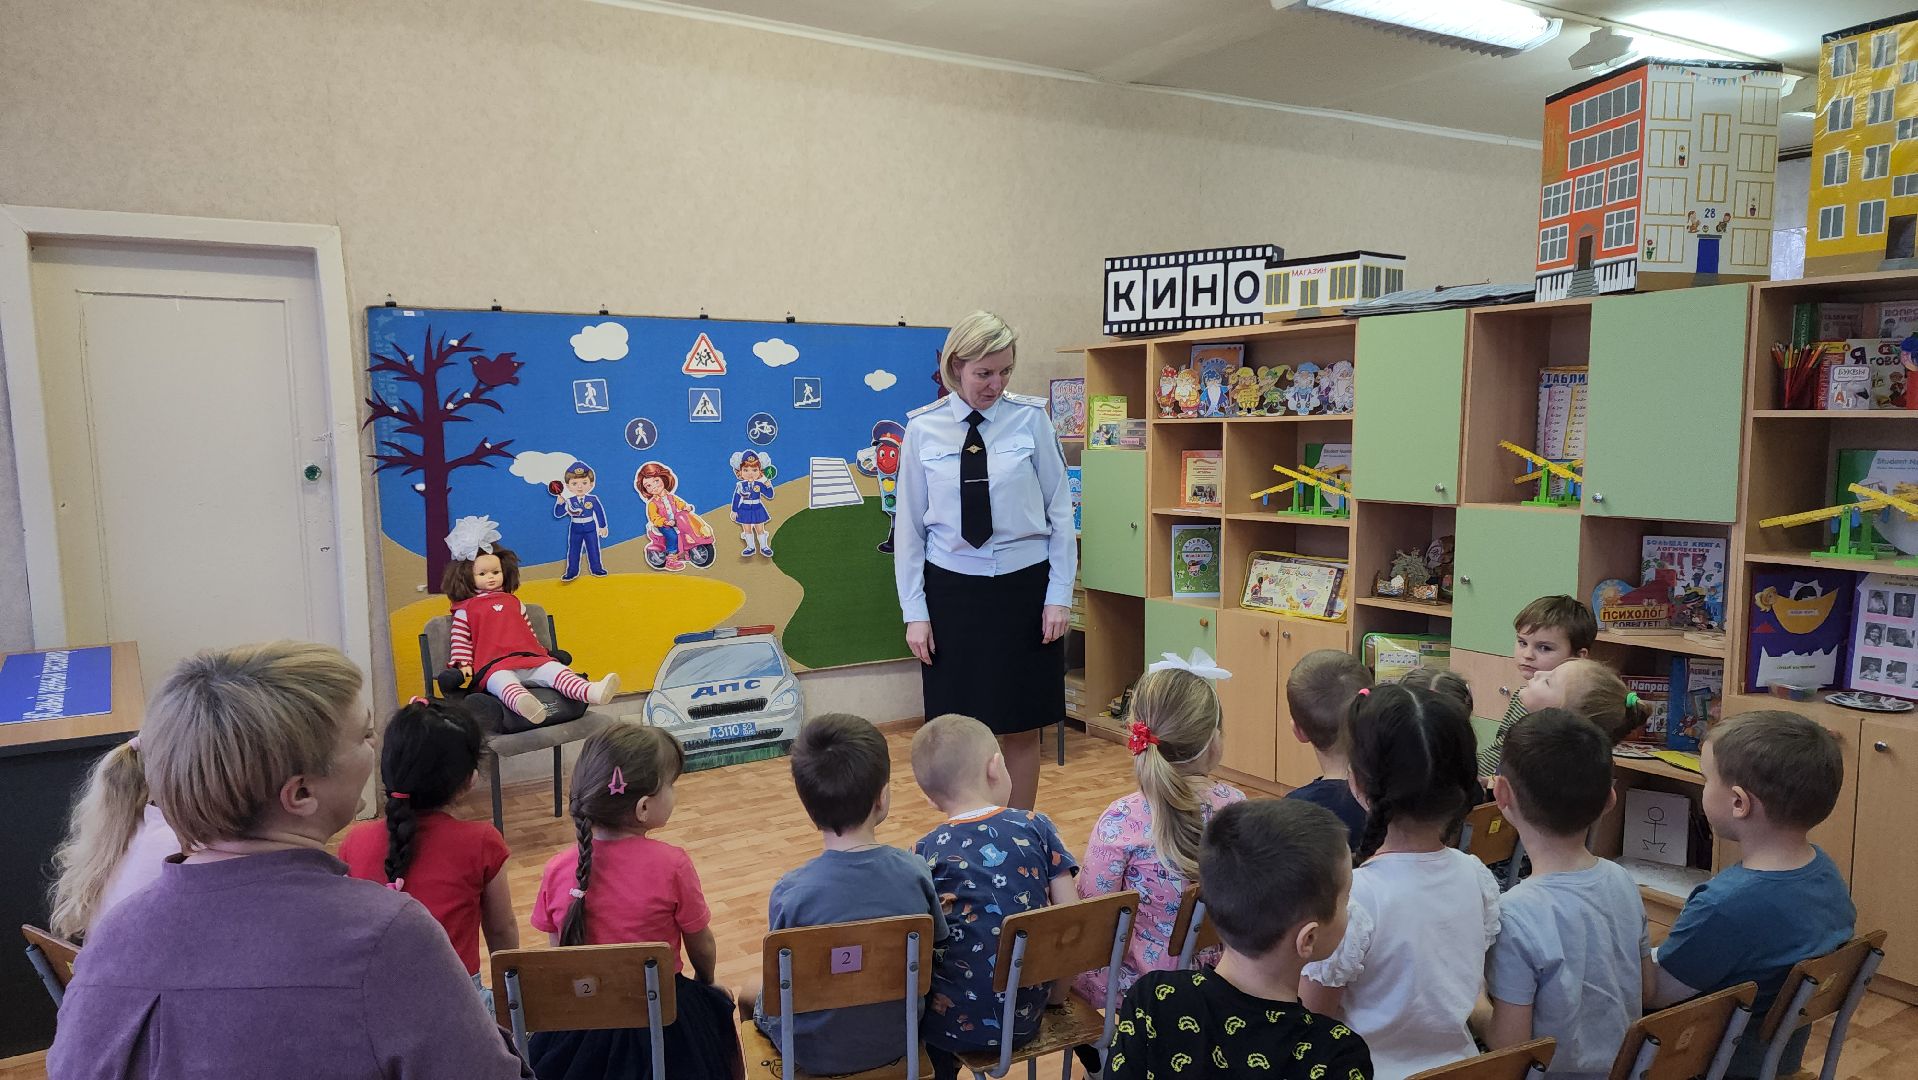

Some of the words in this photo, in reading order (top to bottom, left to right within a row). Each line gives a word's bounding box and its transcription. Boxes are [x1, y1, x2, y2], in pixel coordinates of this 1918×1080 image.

[1703, 207, 1717, 220] 28
[1290, 265, 1329, 278] МАГАЗИН
[1112, 269, 1261, 313] КИНО
[1851, 347, 1867, 364] Я
[1545, 373, 1588, 384] ТАБЛИ
[1602, 608, 1665, 621] ПСИХОЛОГ
[690, 679, 761, 700] ДПС
[841, 951, 852, 966] 2
[581, 982, 592, 995] 2
